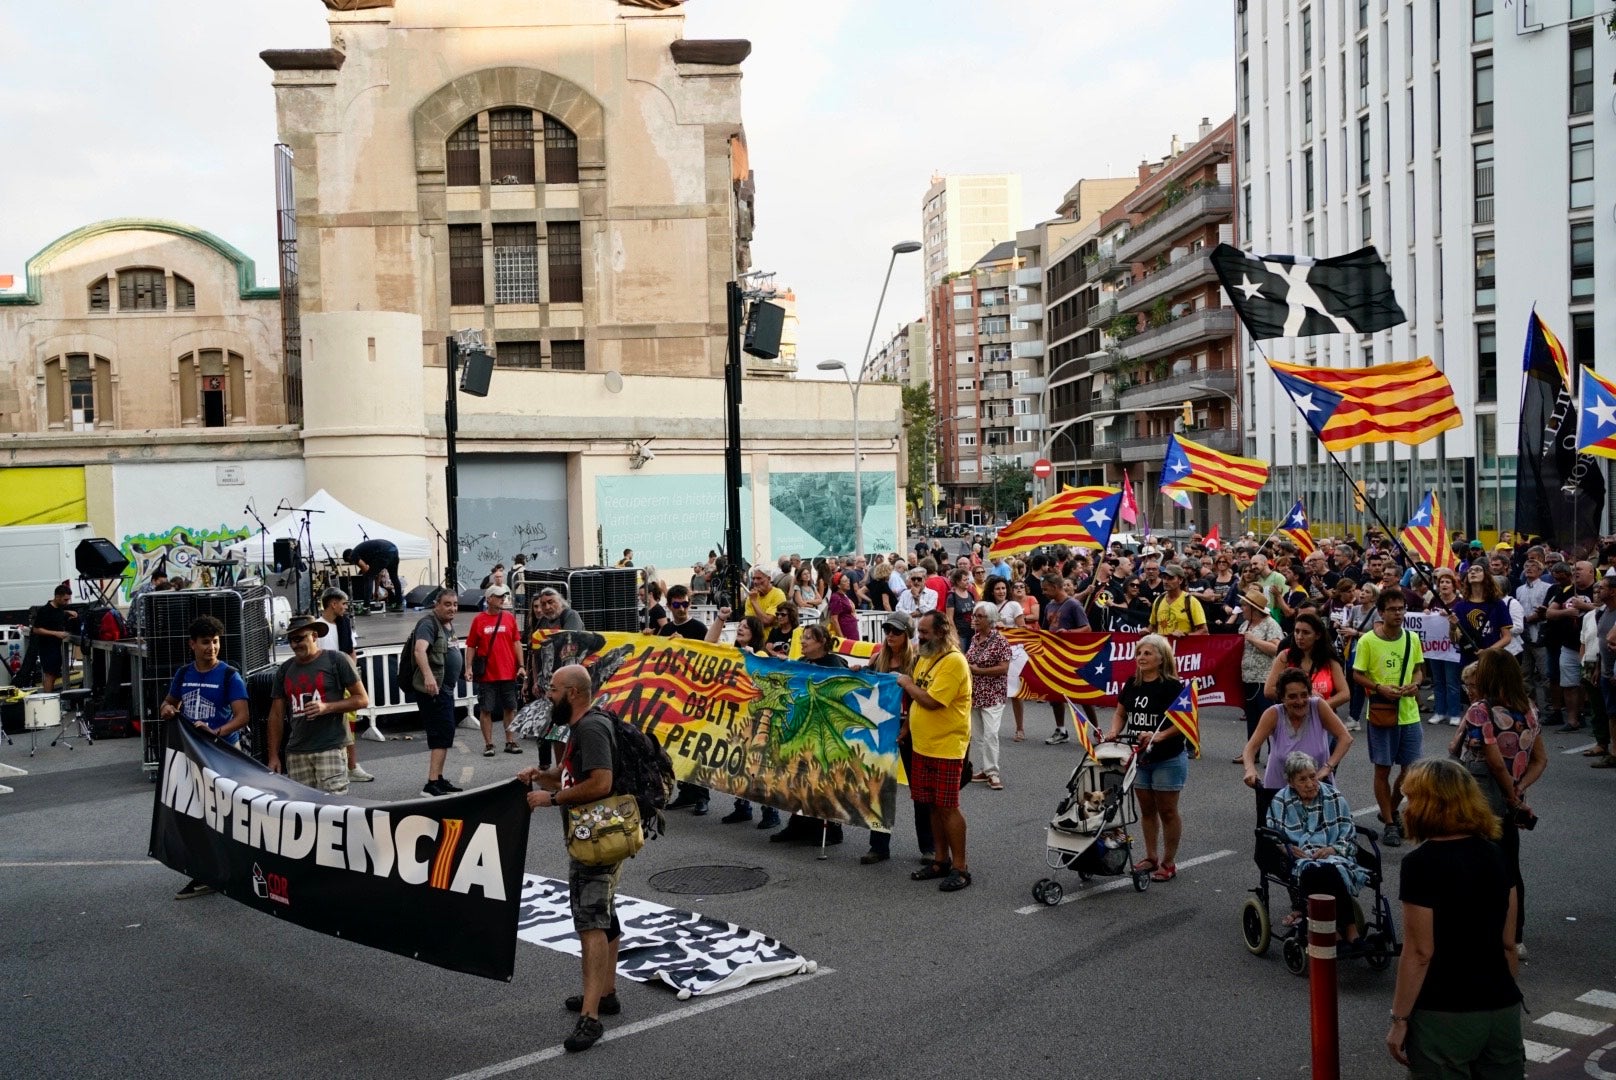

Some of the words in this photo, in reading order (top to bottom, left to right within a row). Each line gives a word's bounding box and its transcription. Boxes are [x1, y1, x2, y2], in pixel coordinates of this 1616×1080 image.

[605, 494, 669, 508] Recuperem
[1105, 681, 1119, 696] LA
[682, 691, 740, 730] OBLIT
[1133, 712, 1158, 727] OBLIT
[161, 747, 507, 901] INDEPENDENCIA
